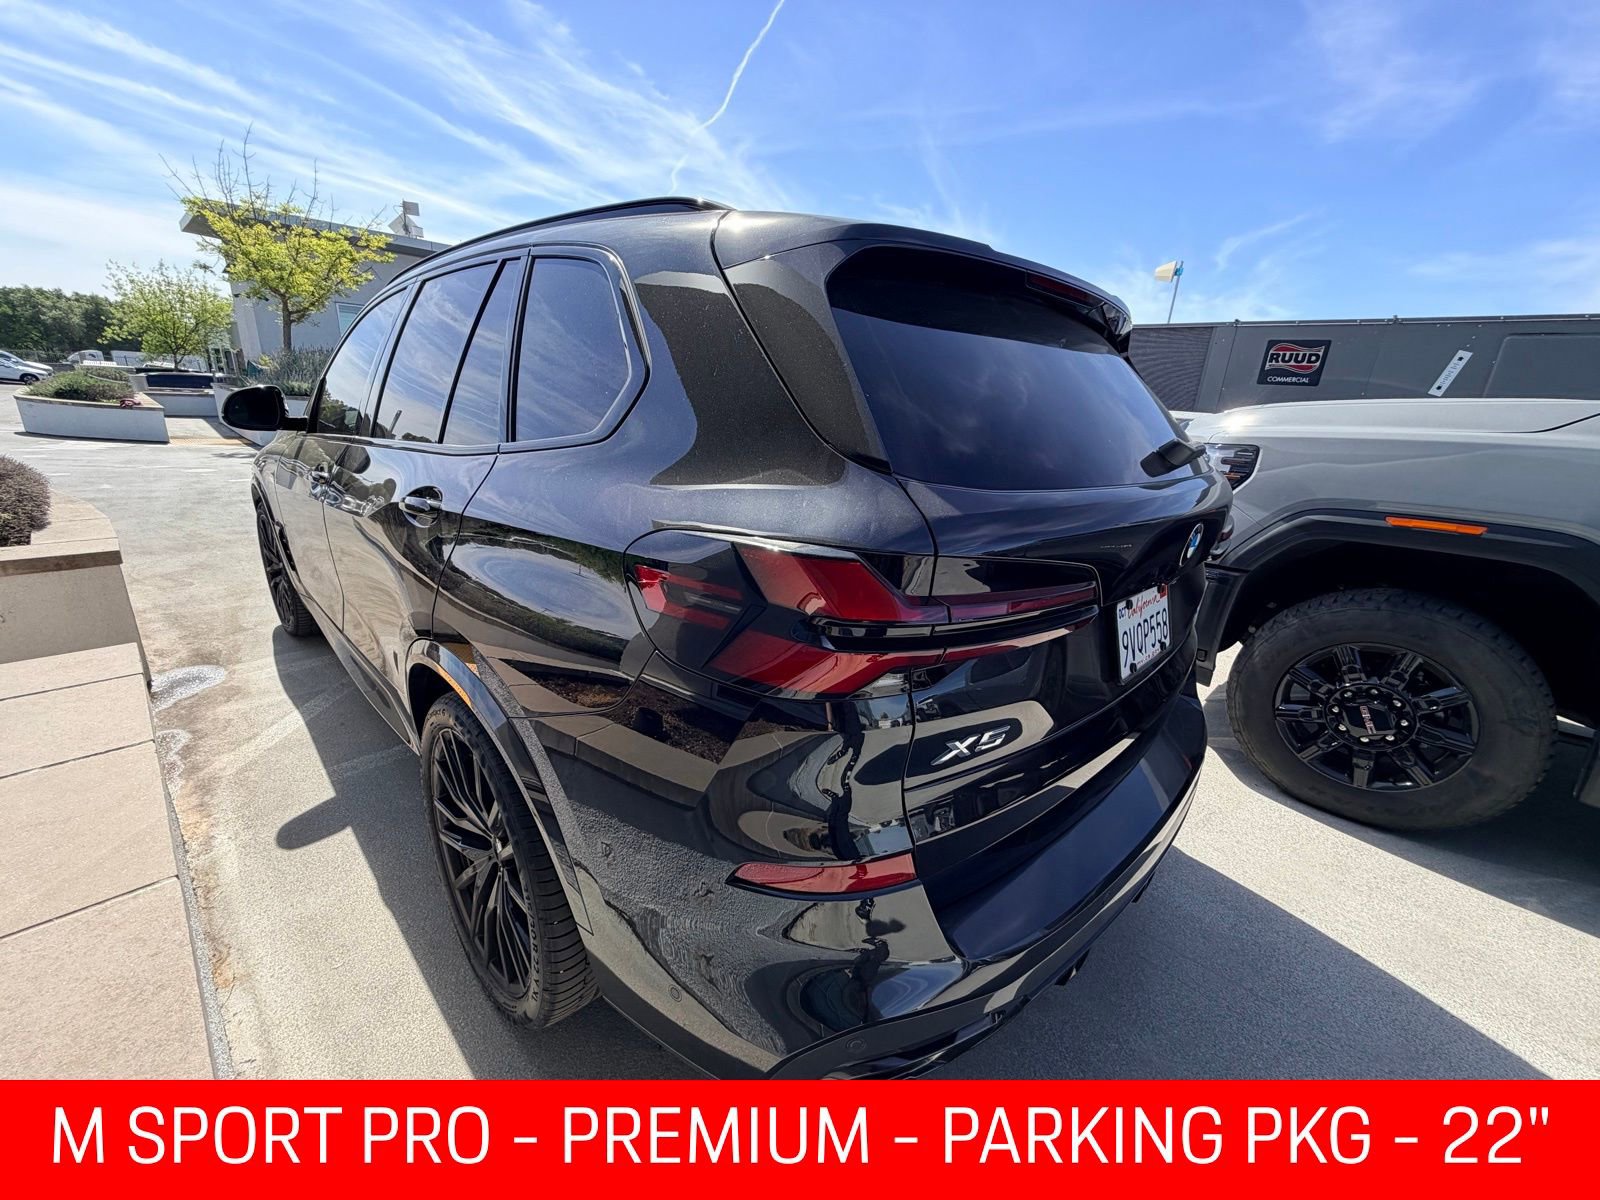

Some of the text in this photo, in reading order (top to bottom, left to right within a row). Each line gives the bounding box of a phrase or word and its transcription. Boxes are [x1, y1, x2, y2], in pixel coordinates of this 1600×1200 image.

[1268, 352, 1321, 364] RUUD
[1122, 608, 1168, 668] 9VQP558
[1360, 705, 1376, 734] GMC
[930, 726, 1011, 766] X5
